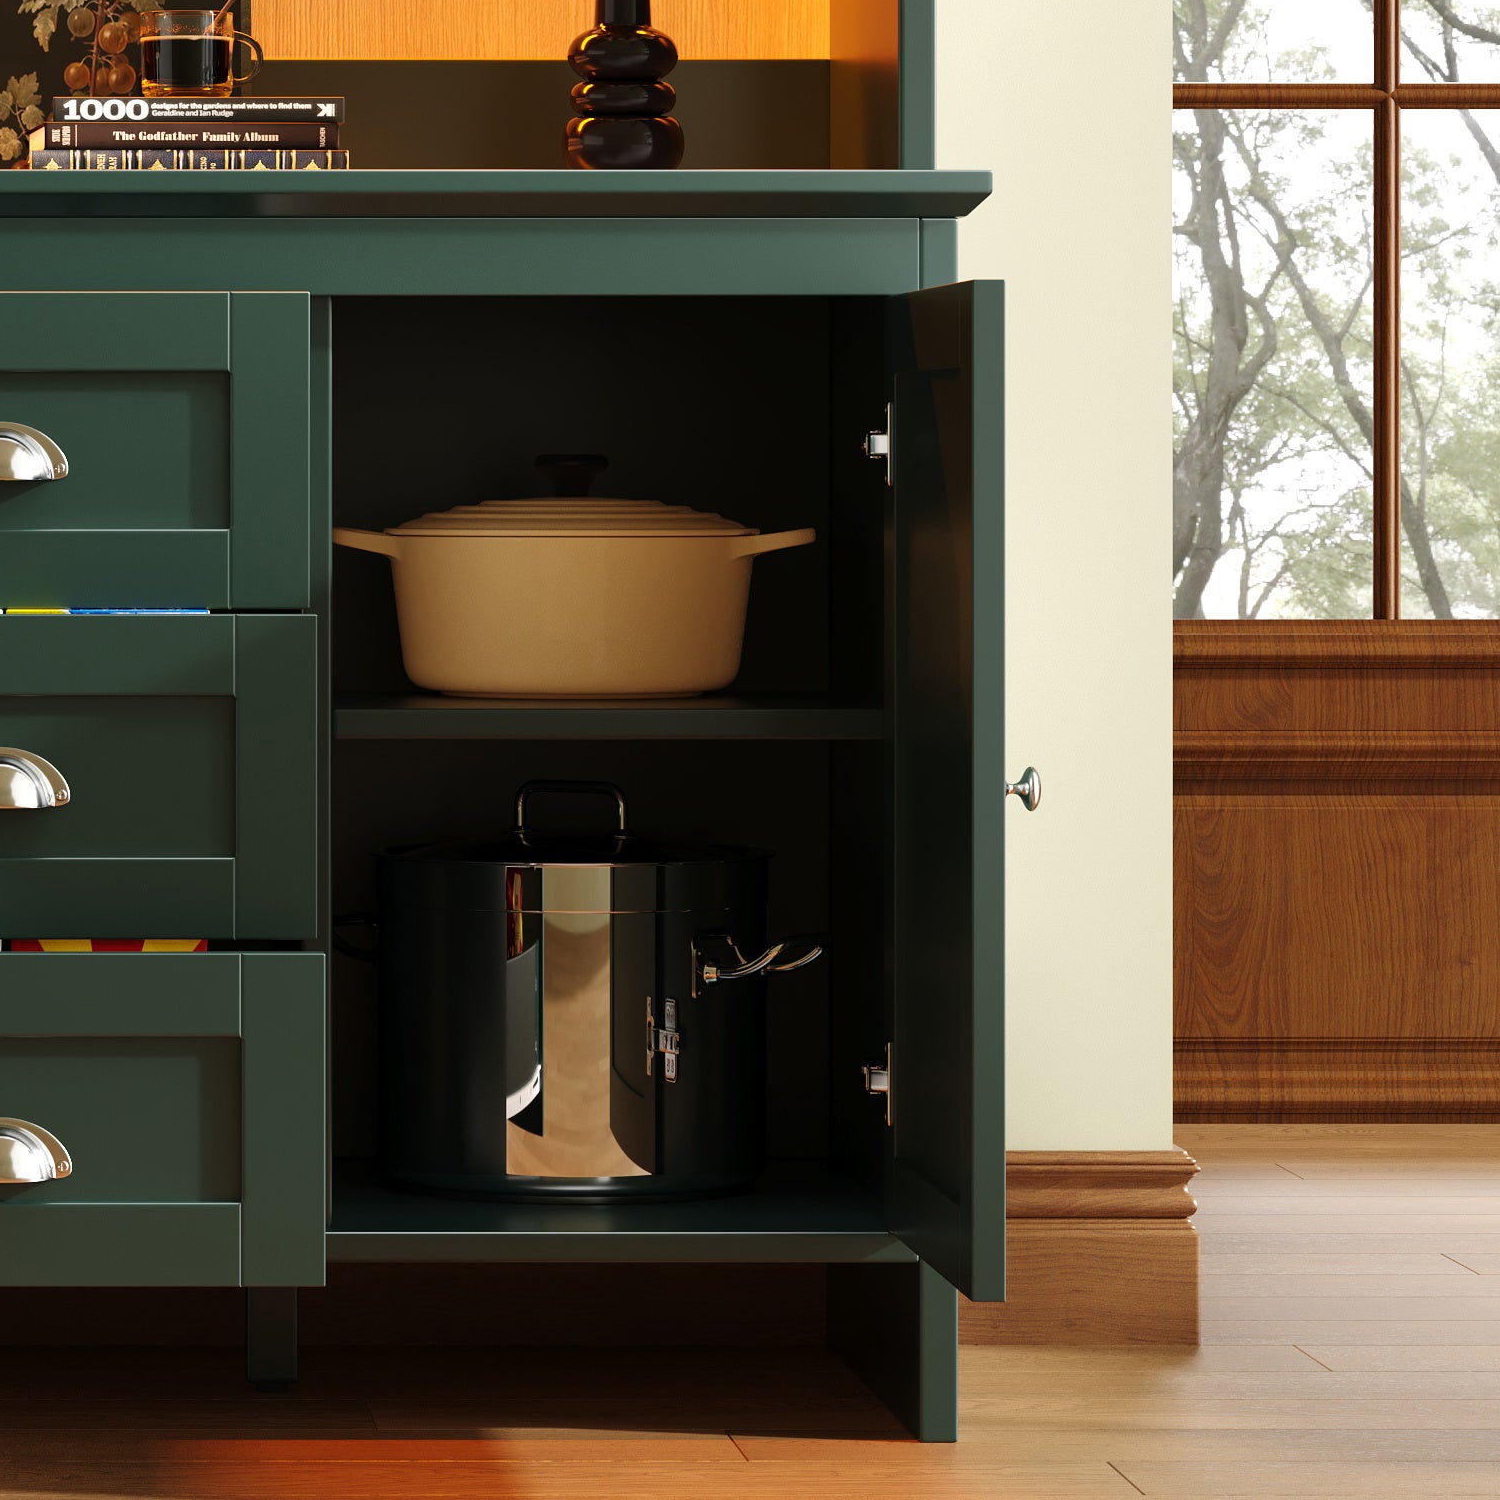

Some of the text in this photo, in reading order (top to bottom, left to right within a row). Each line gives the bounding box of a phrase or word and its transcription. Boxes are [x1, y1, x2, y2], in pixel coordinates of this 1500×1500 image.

[62, 99, 149, 120] 1000
[150, 102, 178, 111] designs
[178, 102, 190, 110] for
[190, 102, 202, 110] the
[203, 102, 232, 111] gardens
[232, 102, 246, 110] and
[246, 102, 269, 110] where
[278, 102, 293, 110] find
[293, 102, 312, 110] them
[151, 109, 234, 118] Geraldine and Ian Rudge
[112, 130, 280, 143] The Godfather Family Album
